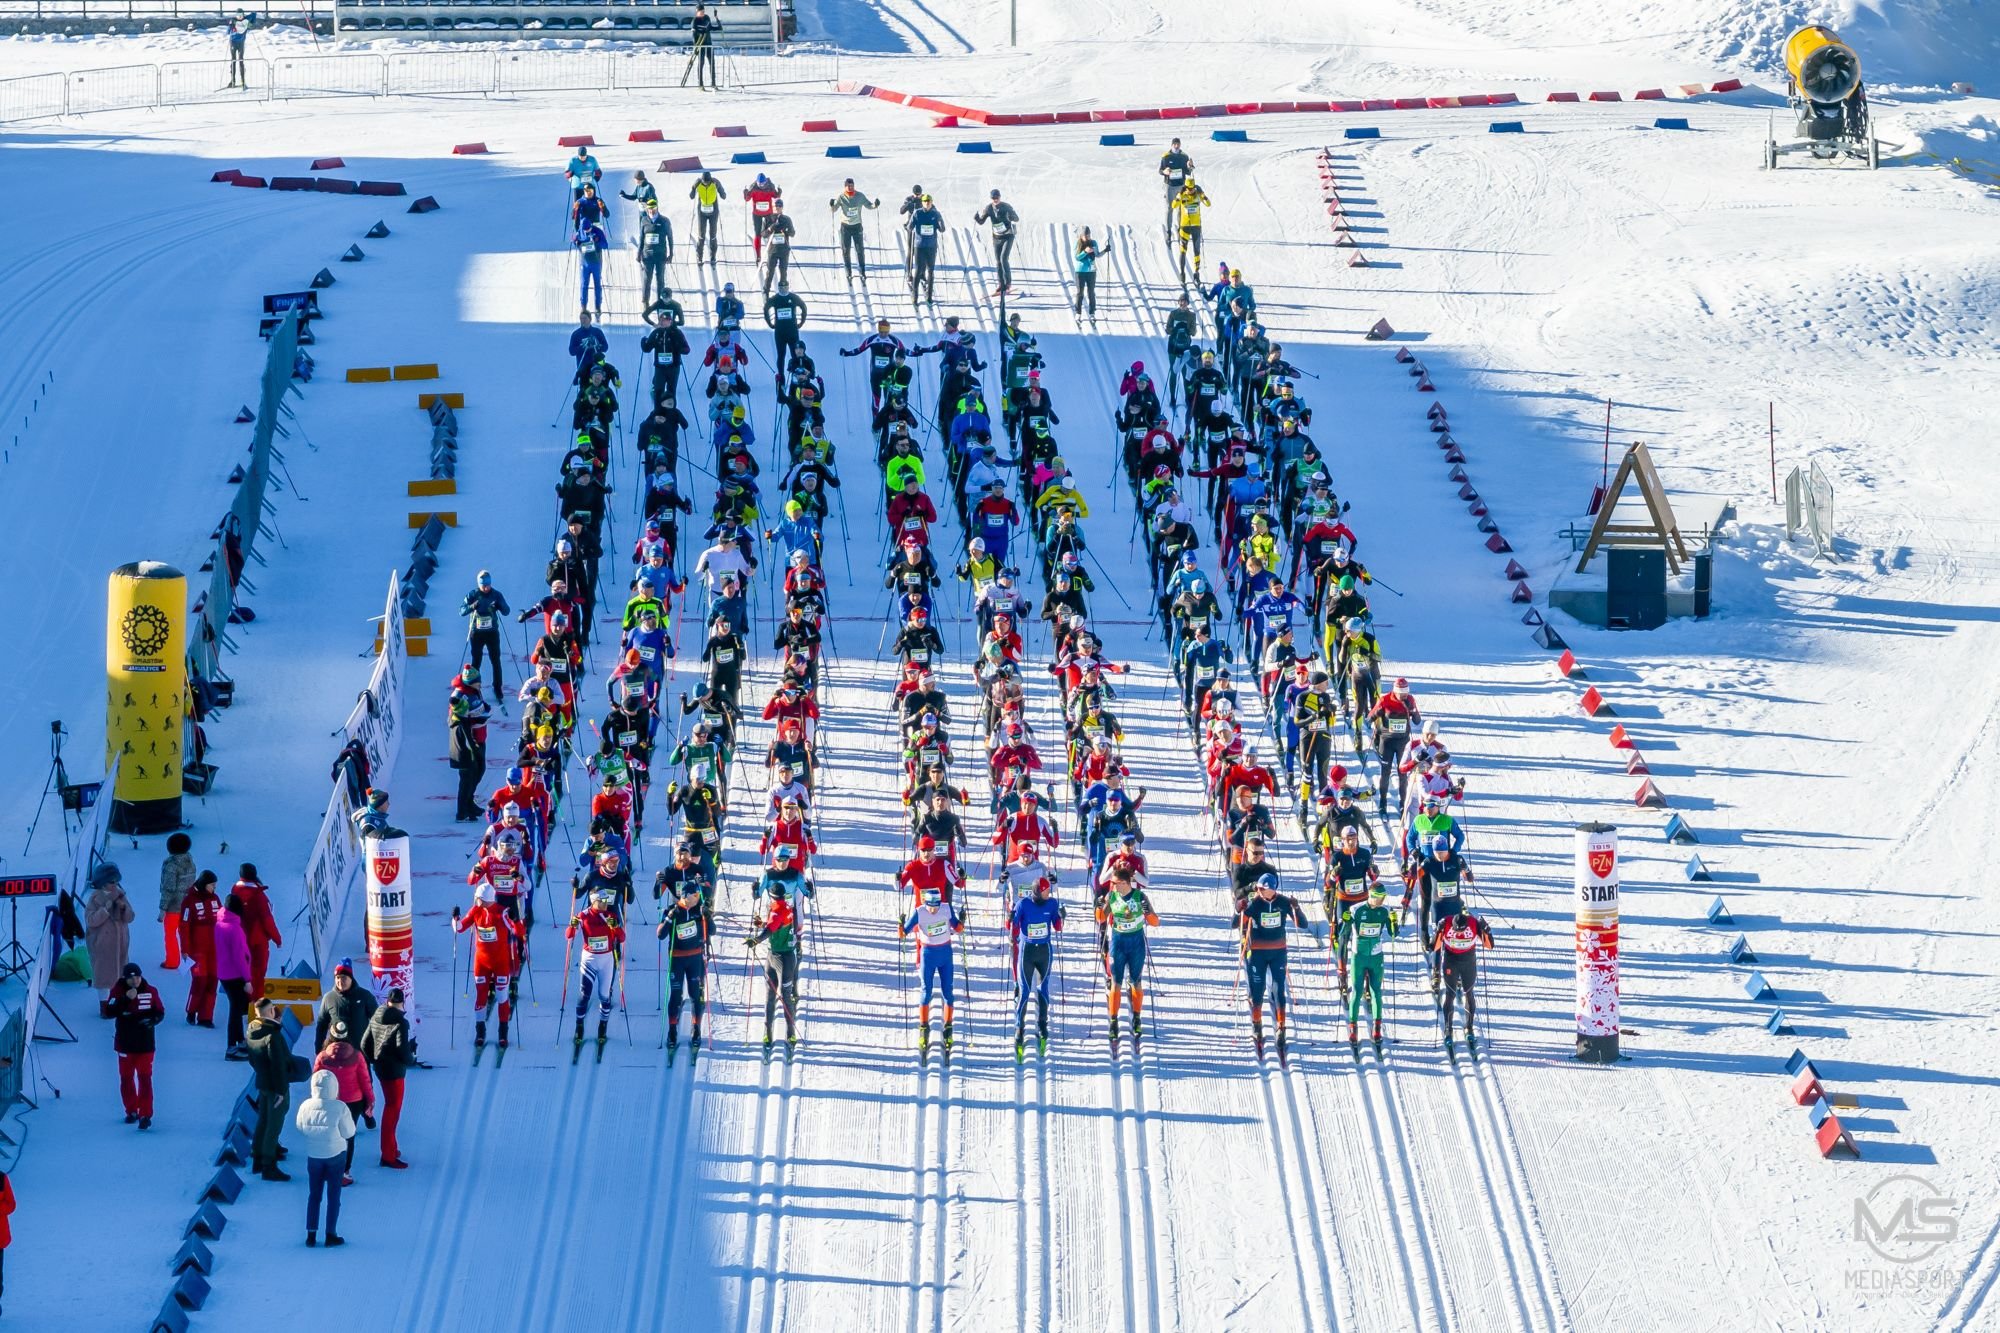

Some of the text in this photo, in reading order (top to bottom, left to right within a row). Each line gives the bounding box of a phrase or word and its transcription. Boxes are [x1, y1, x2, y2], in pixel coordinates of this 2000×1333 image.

[375, 861, 397, 879] PZN
[1592, 854, 1612, 872] PZN
[369, 891, 406, 907] START
[1582, 884, 1618, 902] START
